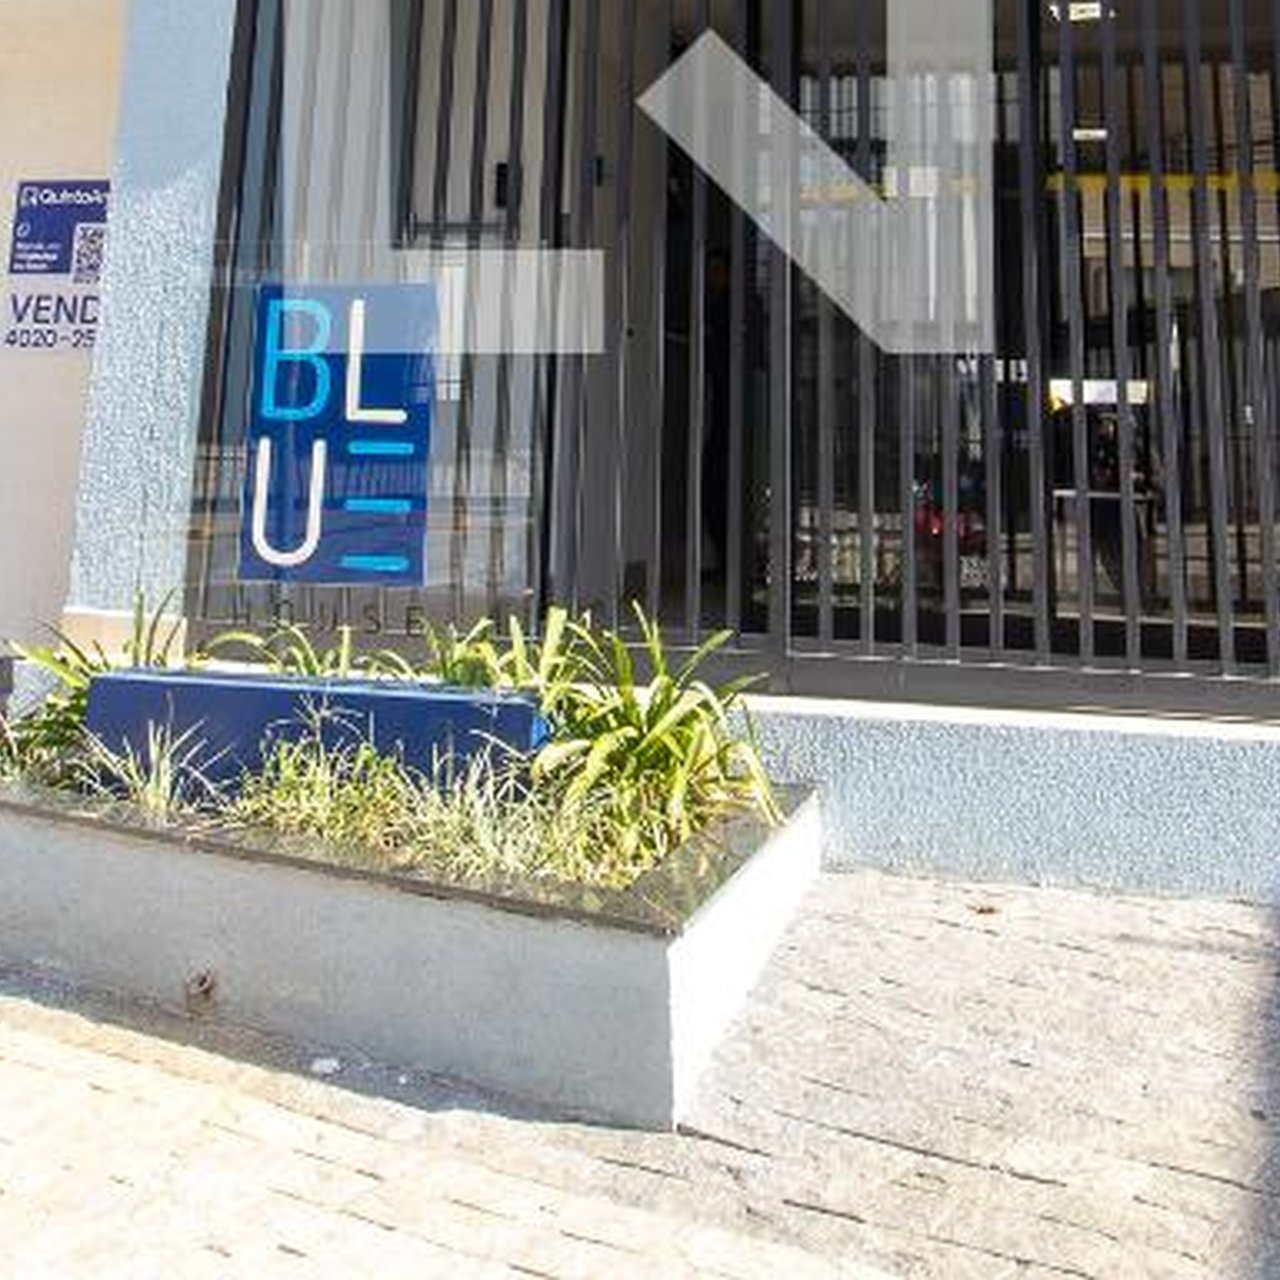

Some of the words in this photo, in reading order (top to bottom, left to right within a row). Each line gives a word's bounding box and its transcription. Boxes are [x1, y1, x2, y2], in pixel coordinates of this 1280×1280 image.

[10, 293, 101, 325] VEND
[4, 328, 98, 348] 4020-25
[232, 598, 424, 637] HOUSE
